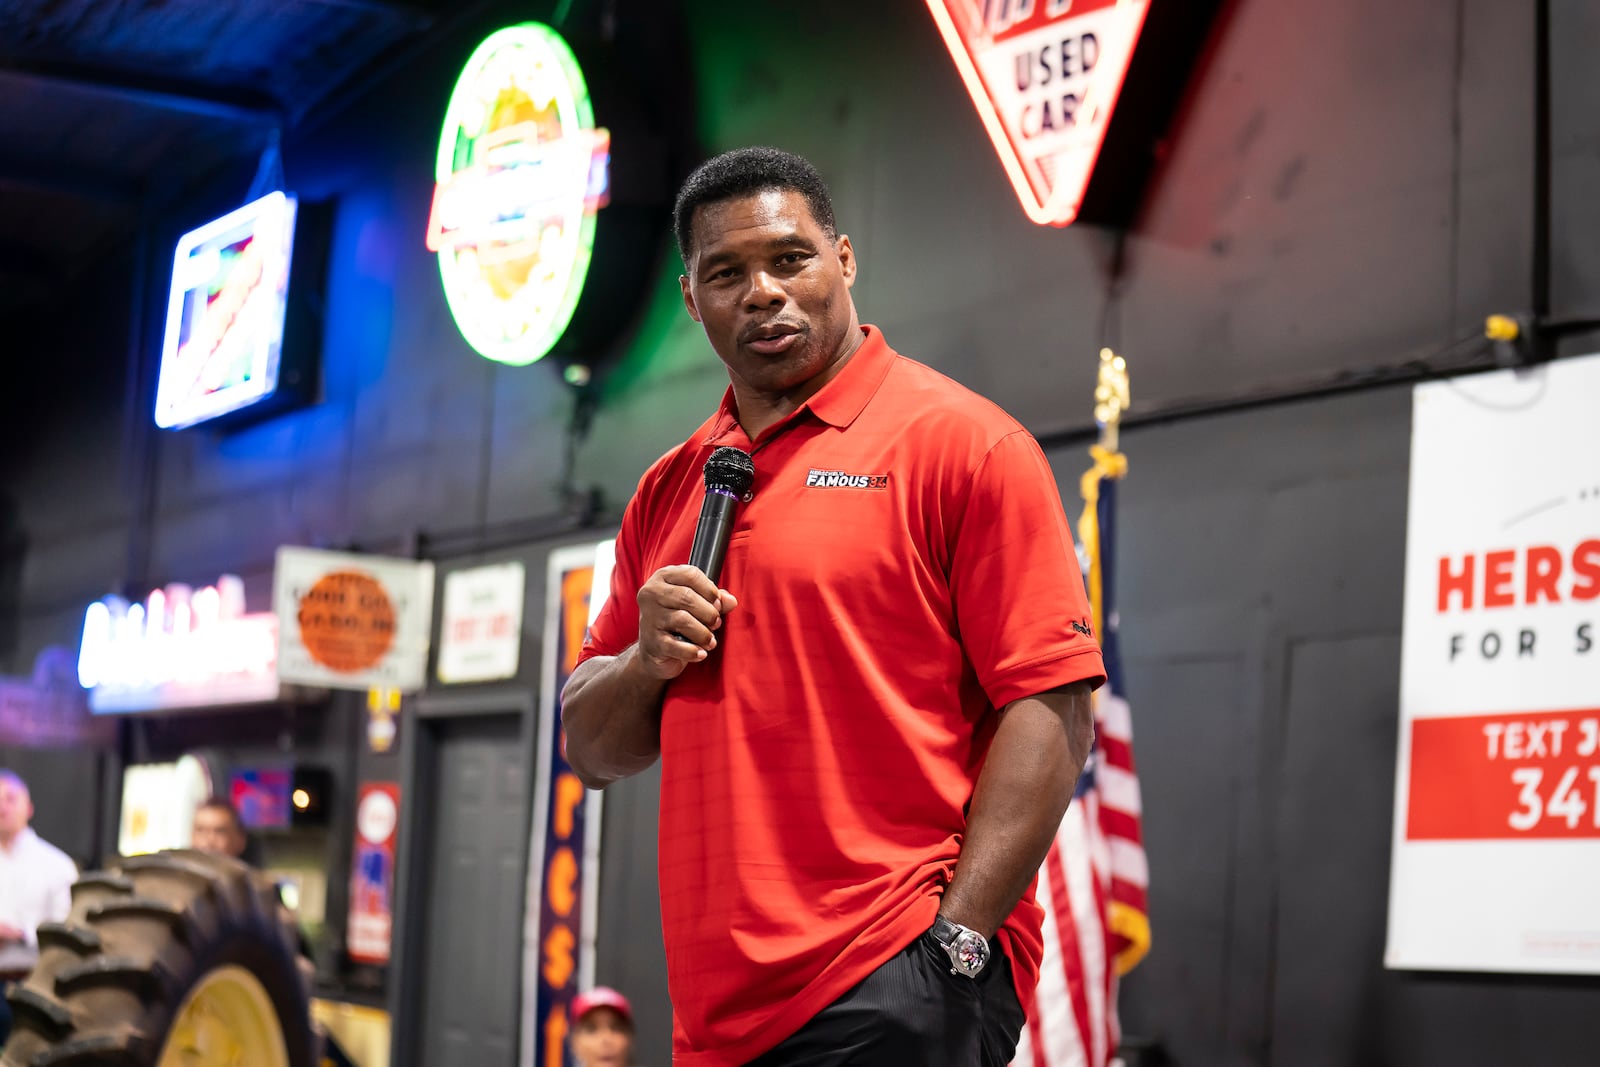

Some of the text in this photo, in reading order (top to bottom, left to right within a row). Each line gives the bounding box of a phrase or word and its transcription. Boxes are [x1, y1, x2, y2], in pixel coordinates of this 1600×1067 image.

[1015, 32, 1100, 92] USED
[806, 475, 869, 488] FAMOUS
[1436, 537, 1600, 613] HERS
[1449, 628, 1538, 662] FOR
[1483, 720, 1569, 760] TEXT
